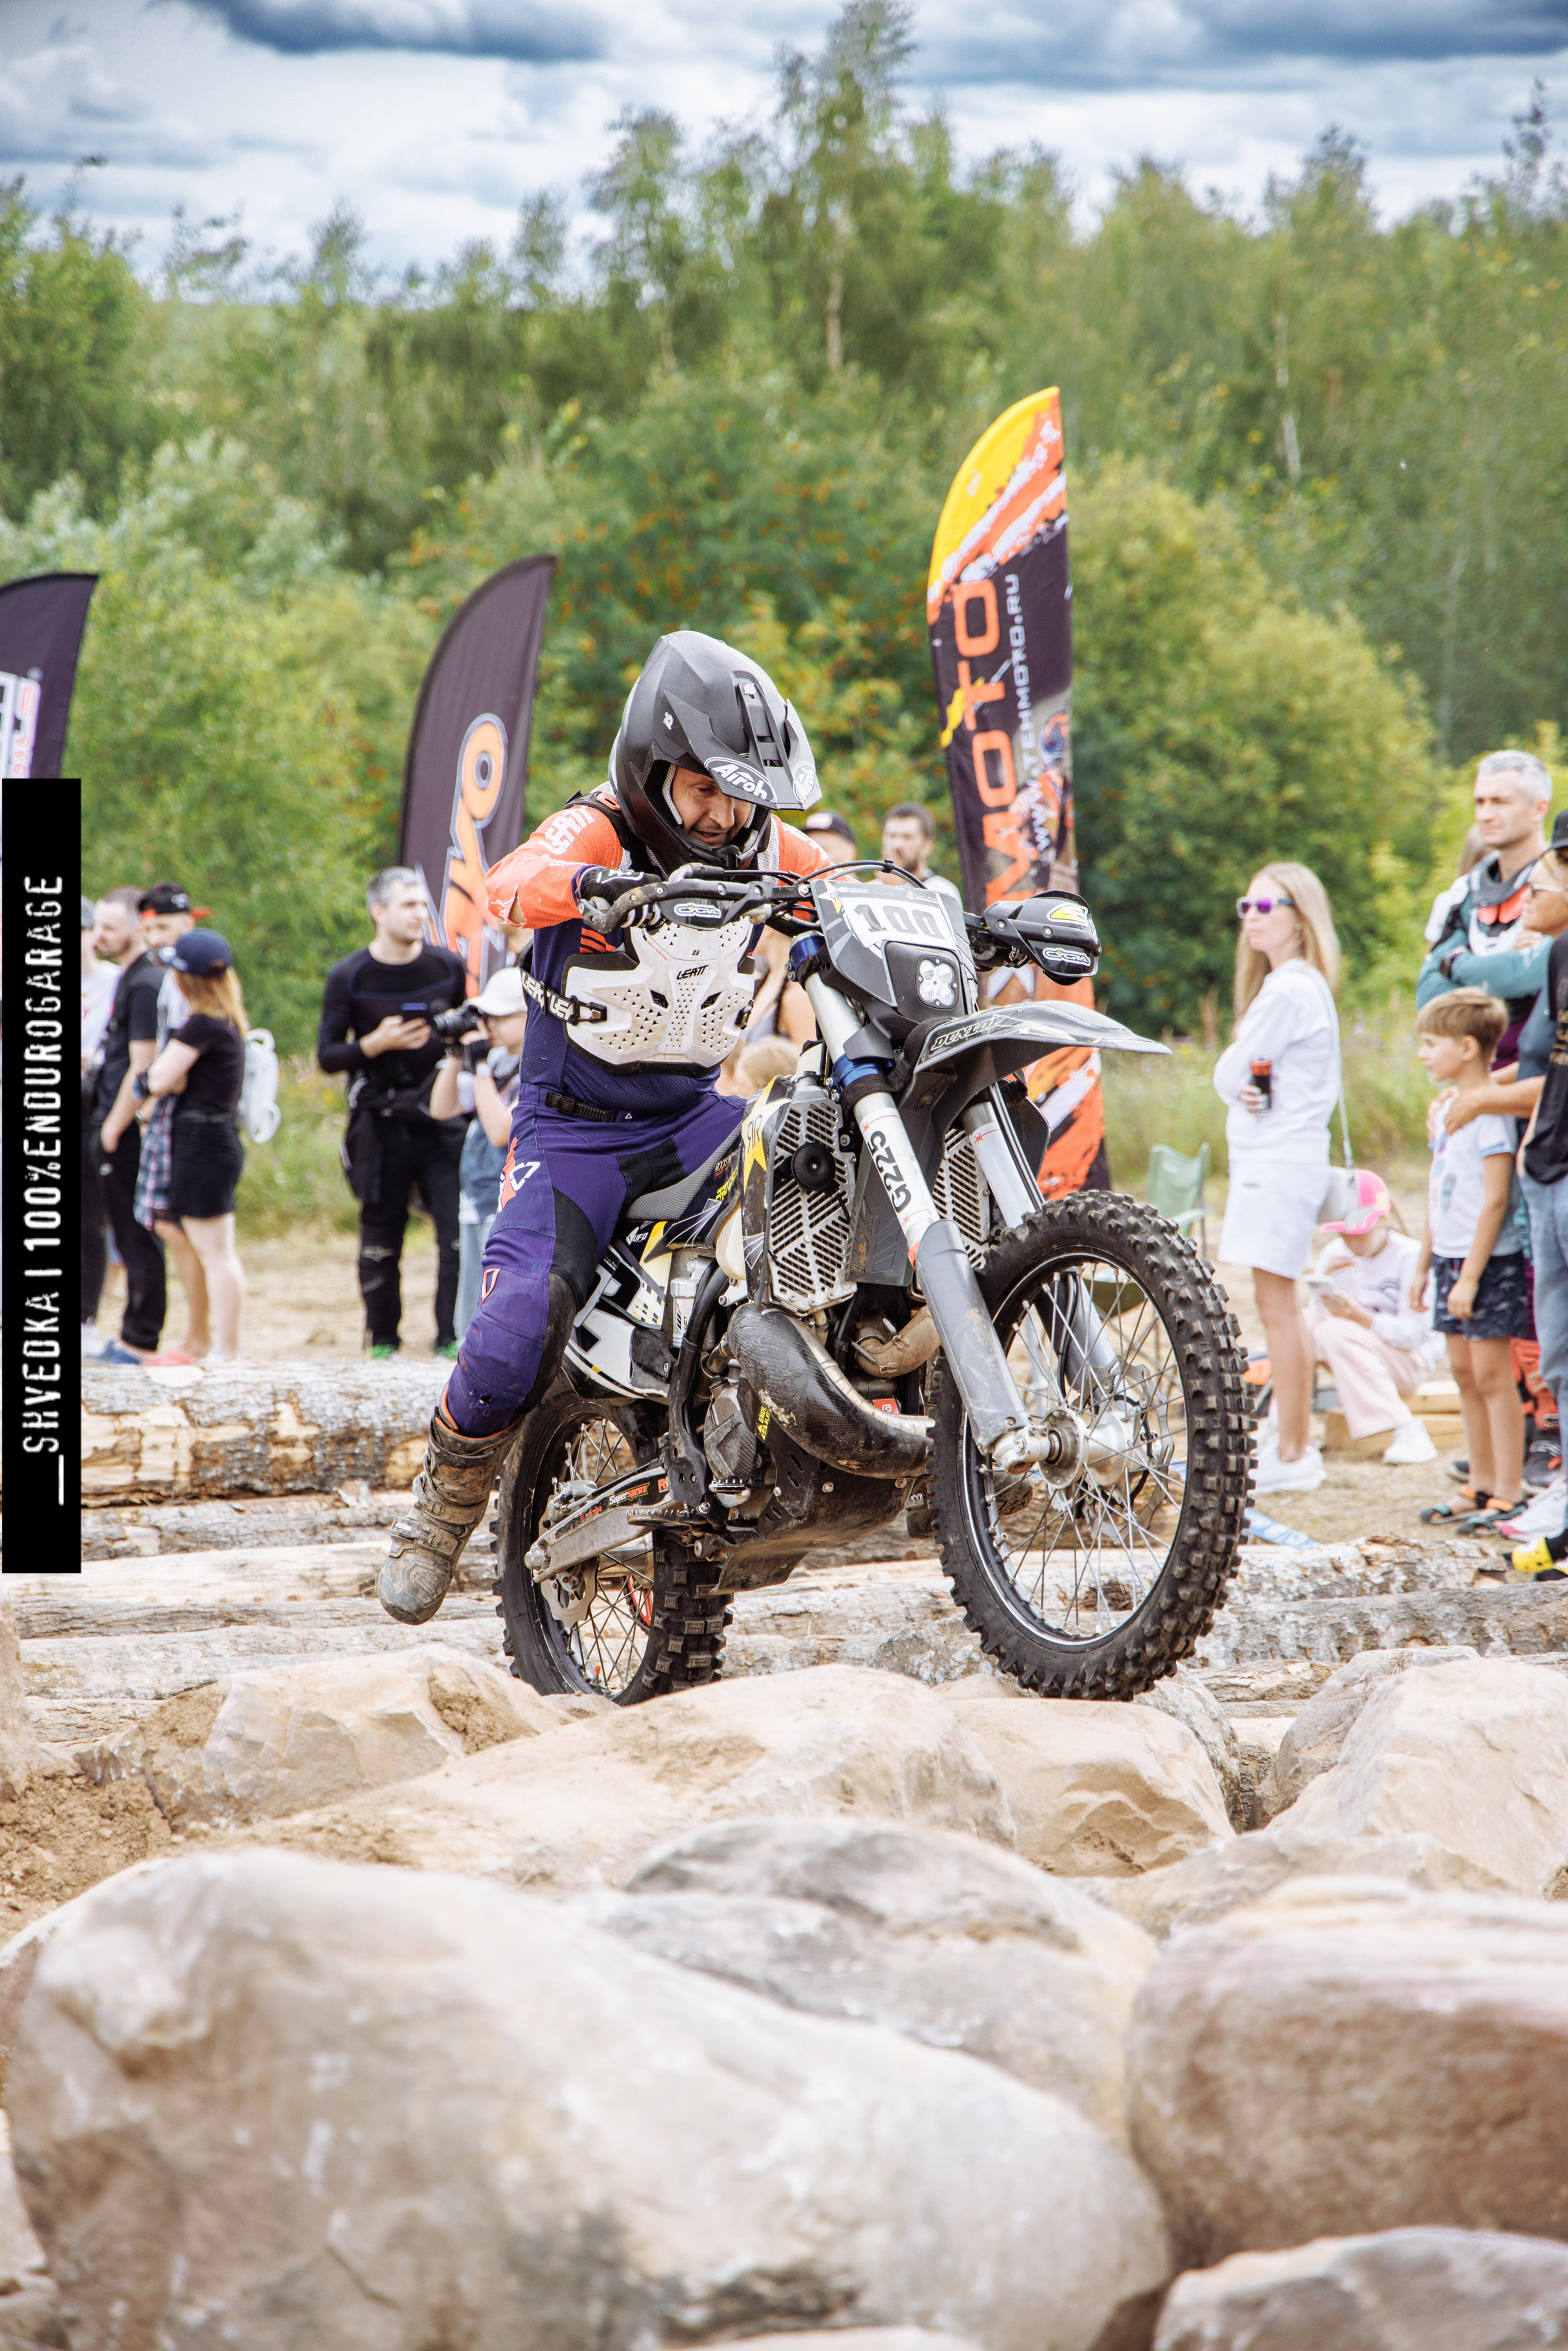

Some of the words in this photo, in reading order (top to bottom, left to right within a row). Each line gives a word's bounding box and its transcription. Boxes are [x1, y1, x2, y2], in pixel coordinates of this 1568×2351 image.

[711, 763, 768, 800] Airoh
[676, 904, 720, 917] CYCRA
[854, 904, 946, 940] 100
[1044, 949, 1090, 965] CYCRA
[676, 964, 709, 980] LEATT
[931, 1014, 1006, 1051] DUNLOP
[633, 1232, 649, 1242] UFO
[609, 1484, 648, 1506] Supersprox
